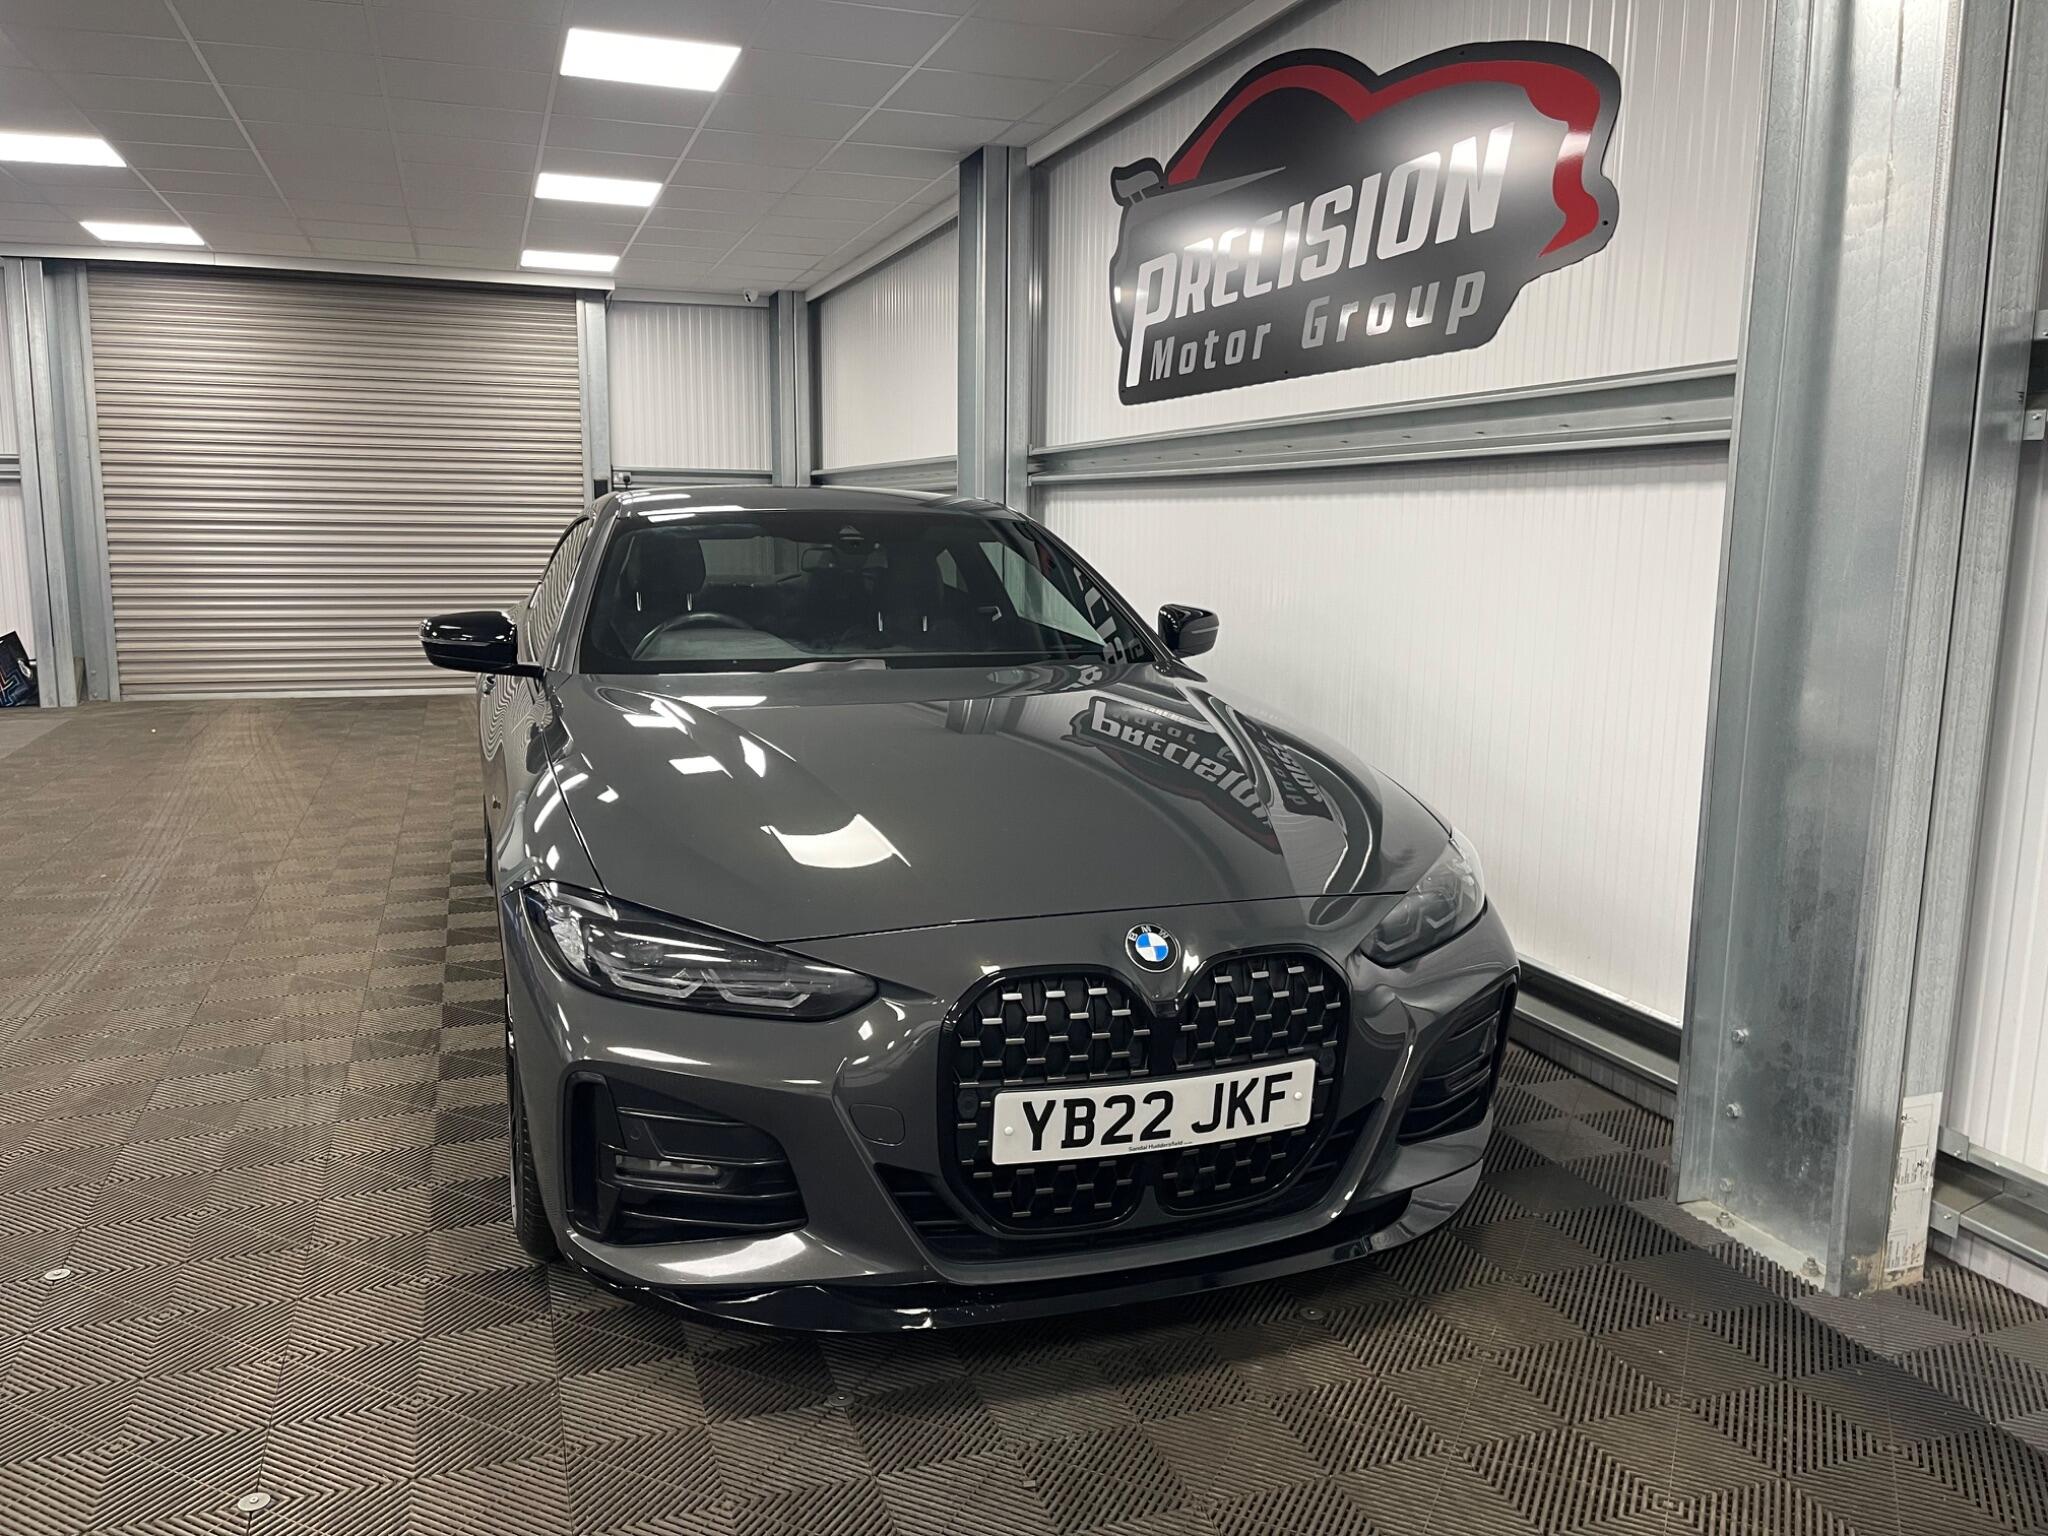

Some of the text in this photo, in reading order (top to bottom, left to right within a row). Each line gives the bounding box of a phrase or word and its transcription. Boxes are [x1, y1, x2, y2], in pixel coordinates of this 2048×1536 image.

[1125, 121, 1515, 388] PRECISION
[1150, 270, 1487, 382] Motor Group
[1022, 1071, 1294, 1151] YB22 JKF
